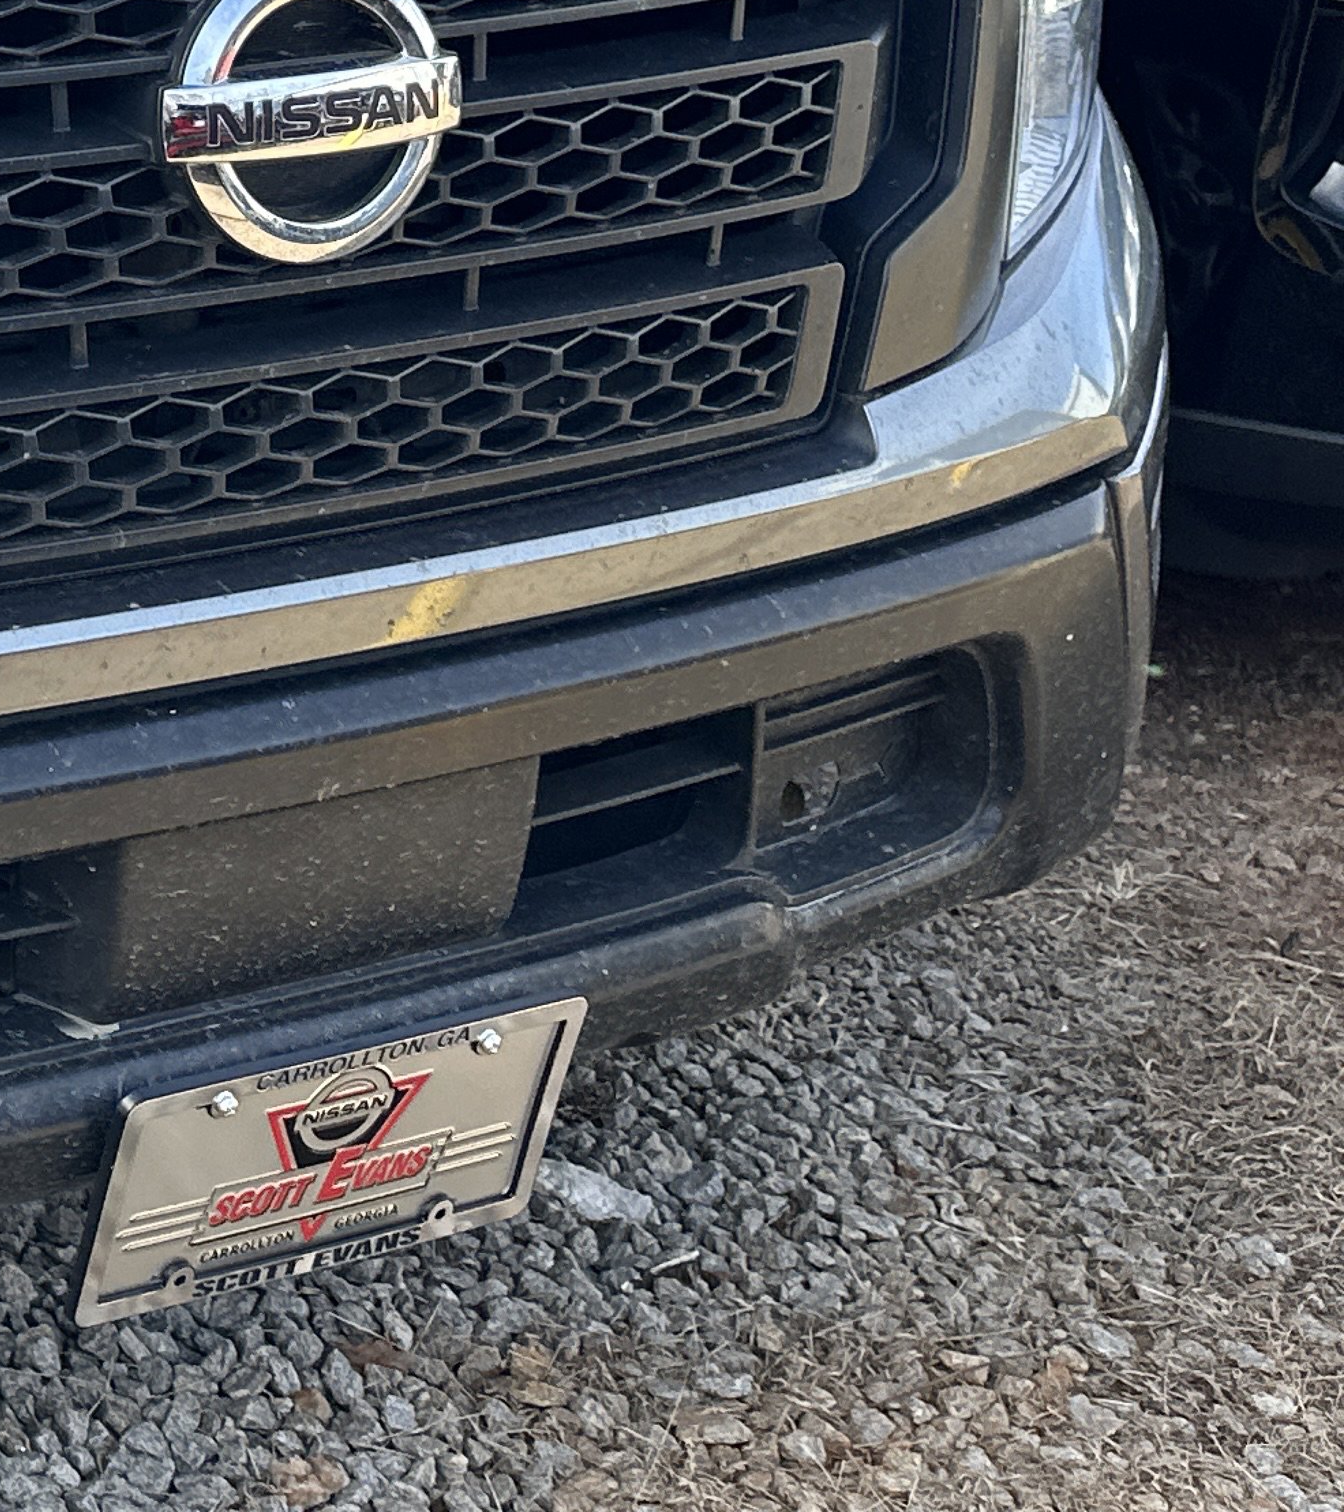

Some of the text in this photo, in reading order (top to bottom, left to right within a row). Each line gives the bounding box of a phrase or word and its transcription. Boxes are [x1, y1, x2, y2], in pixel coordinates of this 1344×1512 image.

[206, 78, 441, 148] NISSAN
[436, 1026, 471, 1049] GA
[301, 1093, 389, 1126] NISSAN
[208, 1143, 432, 1226] SCOTT EVANS
[193, 1226, 422, 1298] SCOTT EVANS
[199, 1203, 399, 1264] CARROLLTON GEORGIA
